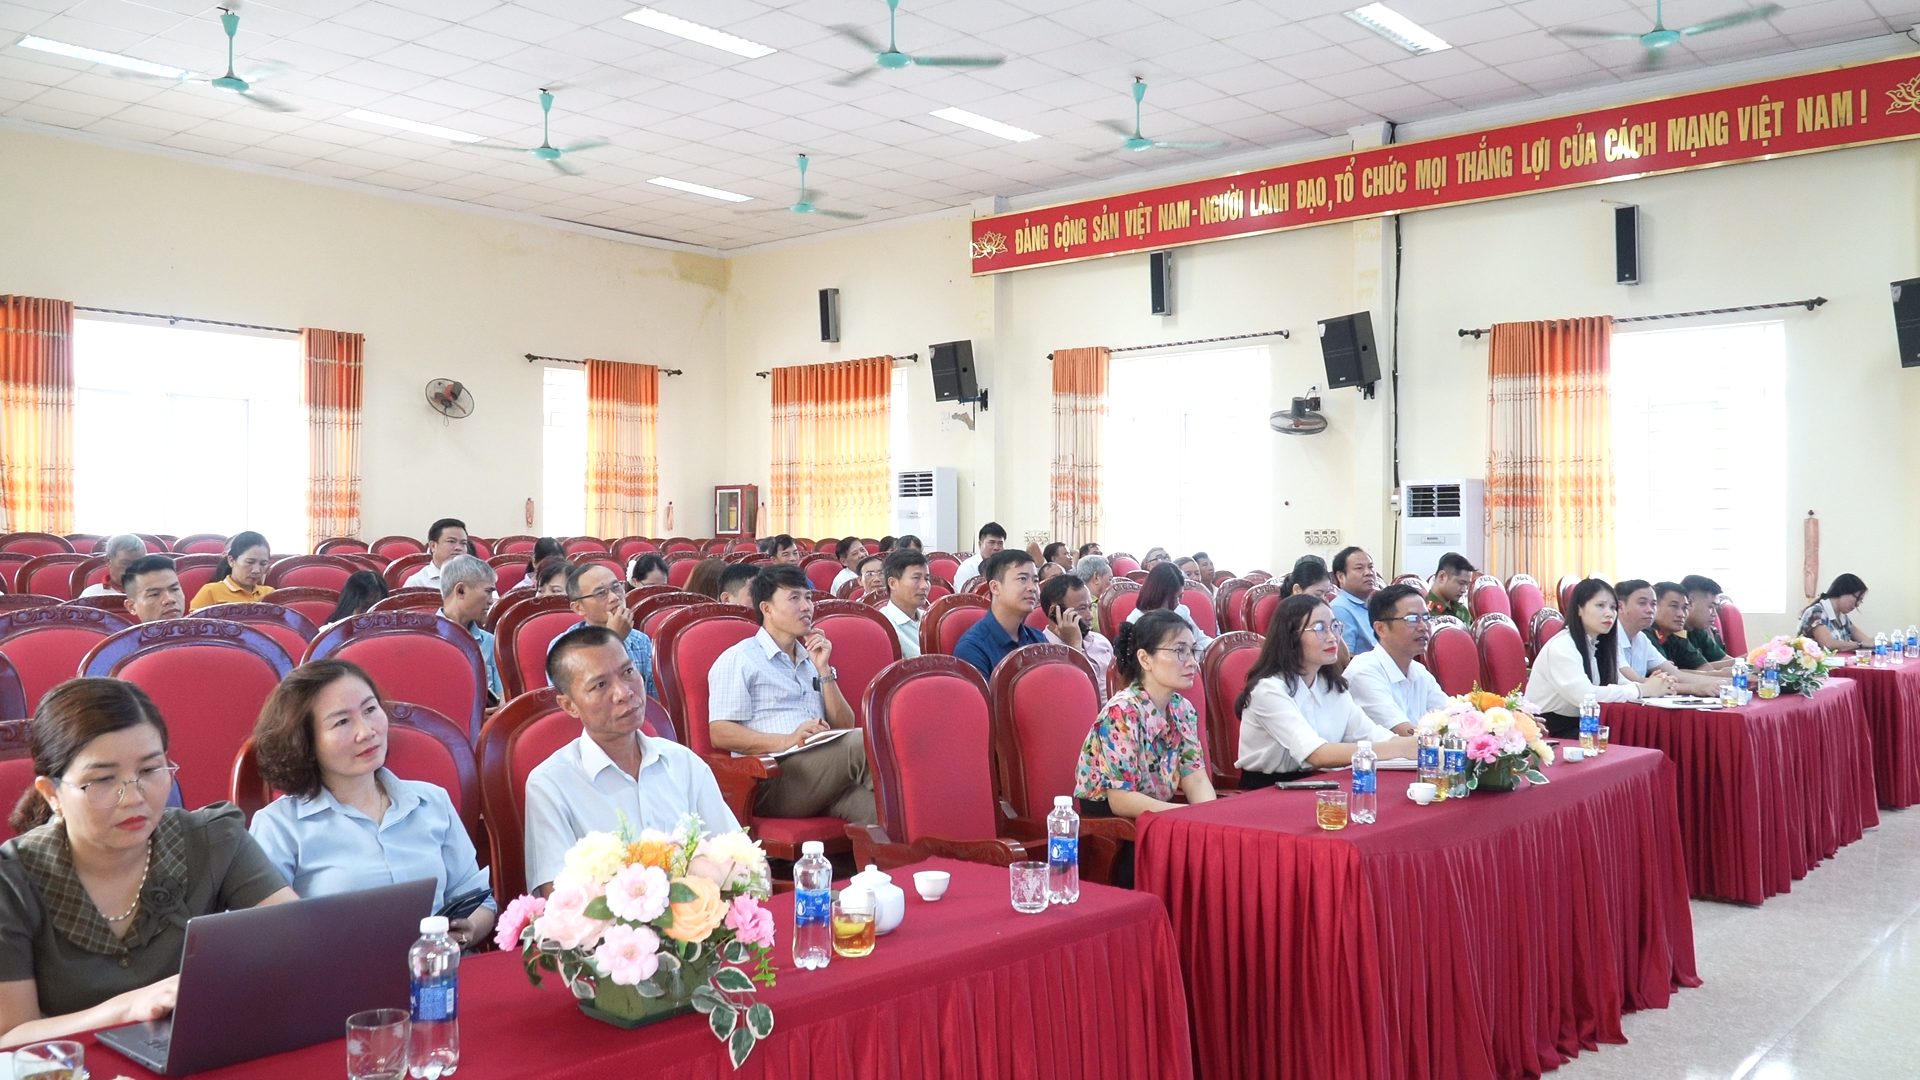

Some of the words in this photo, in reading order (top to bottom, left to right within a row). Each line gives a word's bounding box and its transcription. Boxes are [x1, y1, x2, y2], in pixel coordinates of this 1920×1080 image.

[1015, 218, 1049, 255] ĐẢNG
[1053, 214, 1087, 253] CỘNG
[1092, 204, 1120, 243] SẢN
[1124, 201, 1153, 240] VIỆT
[1250, 179, 1290, 217] LÃNH
[1334, 156, 1356, 204] TỔ
[1362, 155, 1407, 199] CHỨC
[1415, 156, 1447, 195] MỌI
[1455, 135, 1513, 184] THẮNG
[1521, 136, 1551, 181] LỢI
[1559, 122, 1598, 170] CỦA
[1604, 117, 1657, 163] CÁCH
[1667, 110, 1729, 158] MẠNG
[1737, 94, 1785, 147] VIỆT
[1796, 90, 1853, 134] NAM
